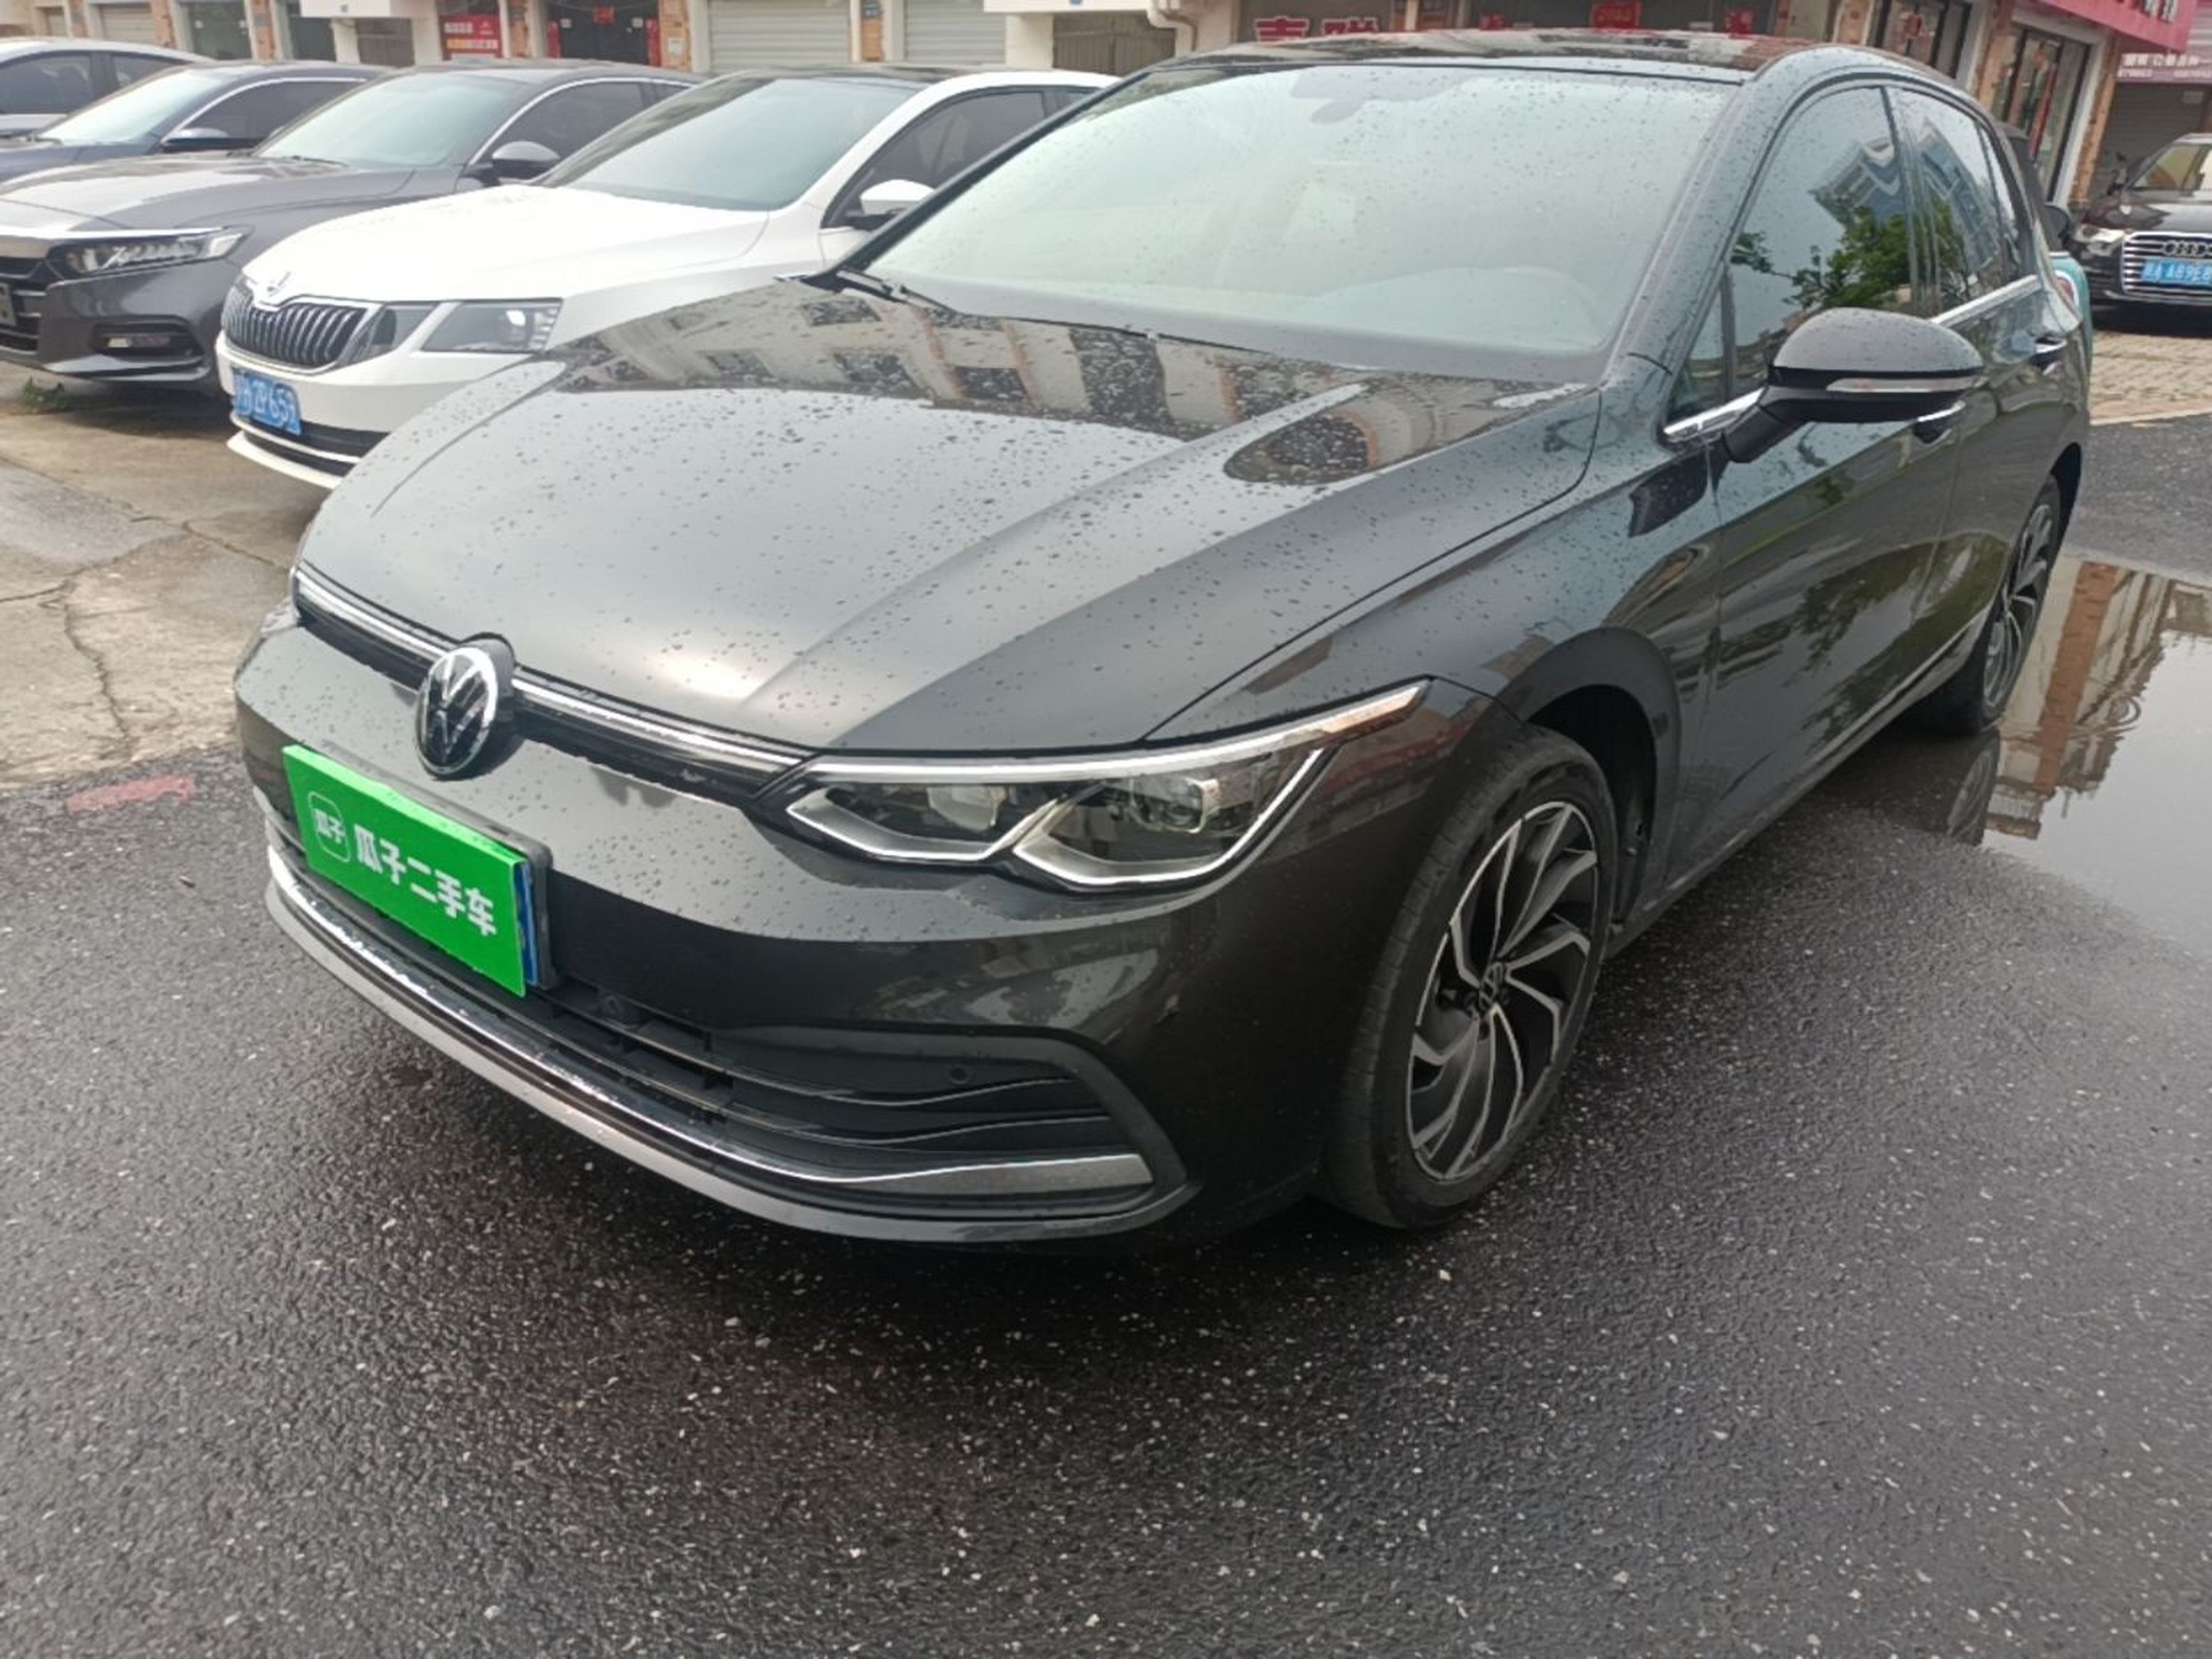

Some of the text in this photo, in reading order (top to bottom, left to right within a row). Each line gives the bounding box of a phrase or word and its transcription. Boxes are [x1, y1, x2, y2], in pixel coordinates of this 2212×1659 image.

[355, 824, 496, 936] 瓜子二手车
